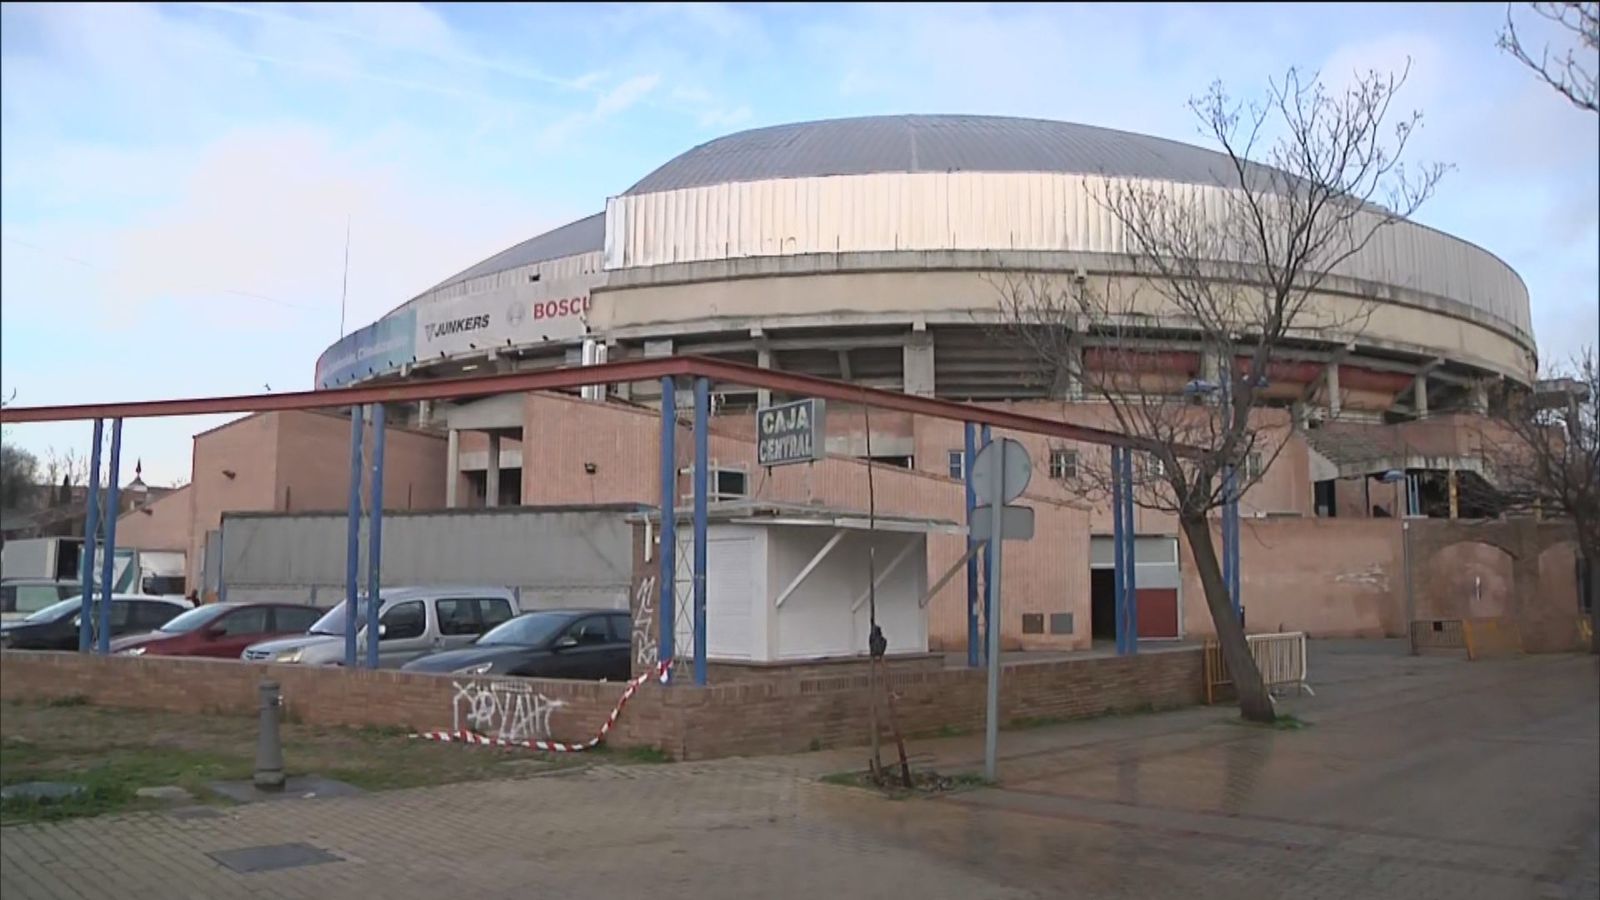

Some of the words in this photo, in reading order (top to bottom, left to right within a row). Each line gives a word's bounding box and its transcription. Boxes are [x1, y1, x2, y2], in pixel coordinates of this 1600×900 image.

[434, 314, 490, 338] JUNKERS
[762, 405, 810, 434] CAJA
[760, 433, 812, 462] CENTRAL
